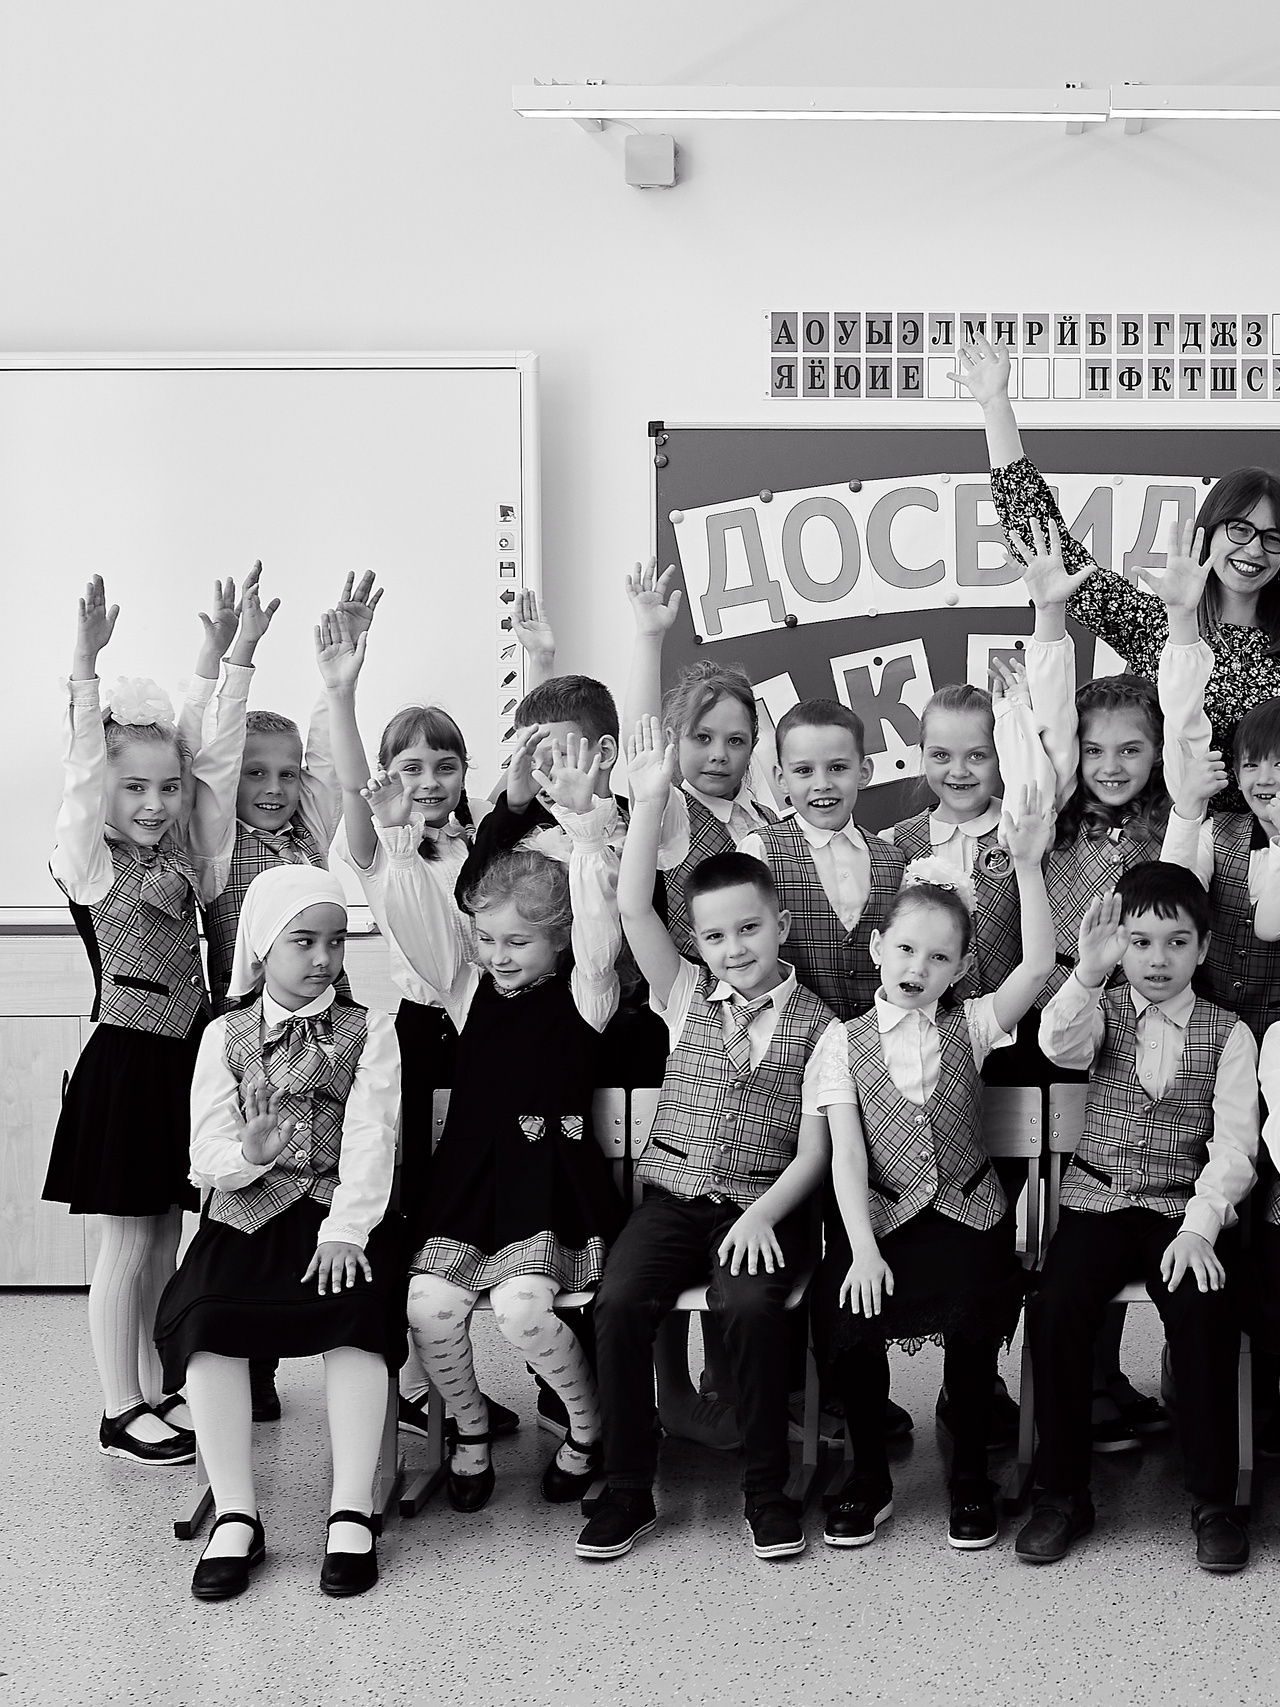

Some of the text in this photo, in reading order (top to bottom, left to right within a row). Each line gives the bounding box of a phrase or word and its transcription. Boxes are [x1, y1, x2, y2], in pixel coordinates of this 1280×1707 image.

[774, 320, 795, 345] А
[806, 320, 825, 345] О
[837, 320, 858, 345] У
[866, 320, 892, 345] Ы
[902, 320, 919, 345] Э
[931, 321, 952, 345] Л
[994, 321, 1016, 345] Н
[1025, 321, 1043, 346] Р
[1057, 315, 1078, 346] Й
[1088, 321, 1106, 346] Б
[1121, 321, 1139, 346] В
[1153, 322, 1170, 346] Г
[1182, 322, 1202, 353] Д
[1210, 322, 1237, 347] Ж
[1246, 322, 1262, 347] З
[774, 365, 795, 389] Я
[808, 359, 825, 389] Ё
[834, 365, 861, 390] Ю
[869, 365, 890, 389] И
[902, 366, 919, 389] Е
[1088, 366, 1110, 391] П
[1118, 366, 1142, 391] Ф
[1151, 366, 1172, 392] К
[1183, 367, 1202, 391] Т
[1210, 367, 1237, 391] Ш
[1246, 366, 1263, 392] С
